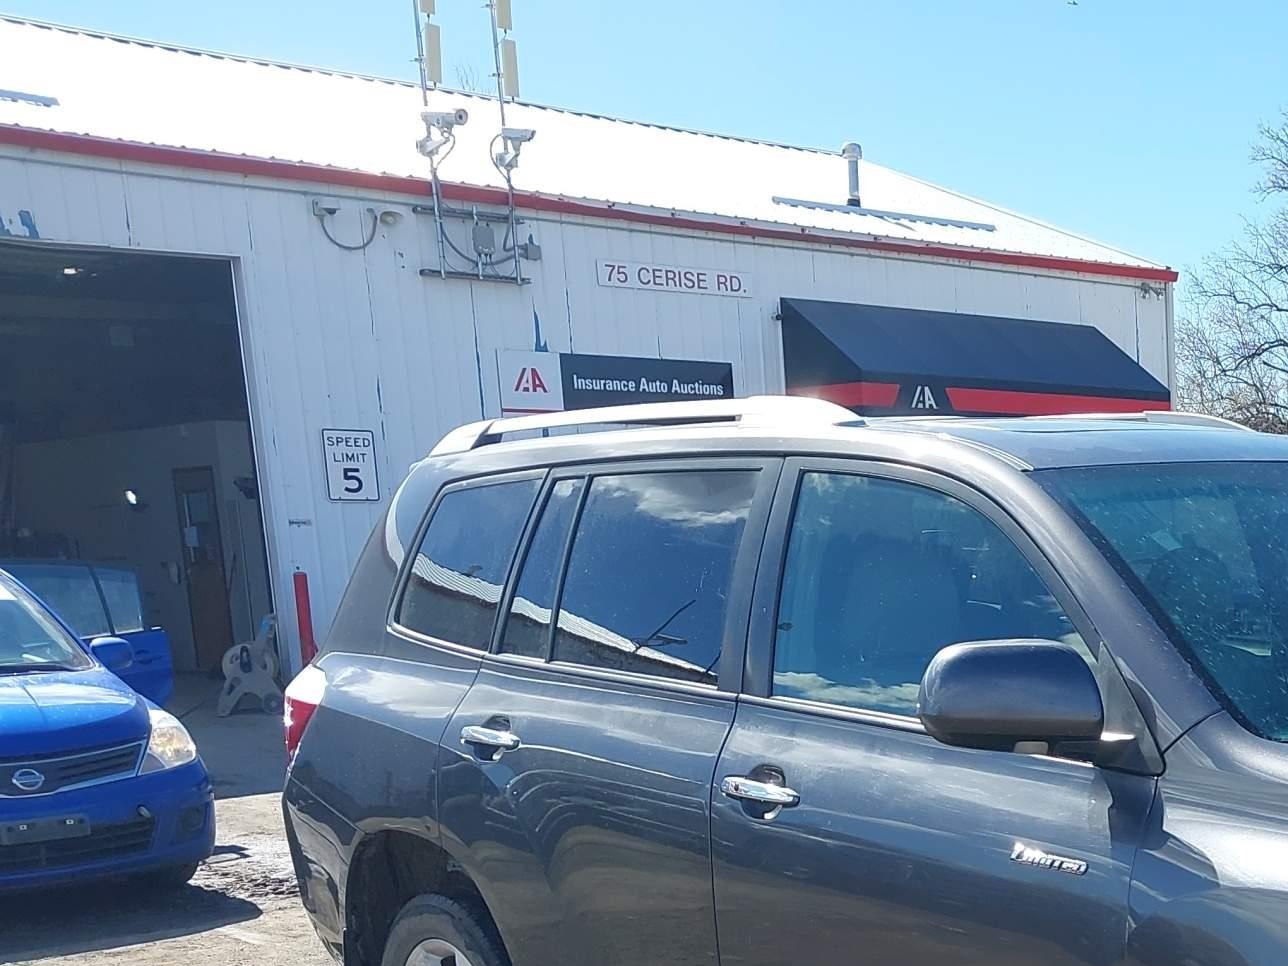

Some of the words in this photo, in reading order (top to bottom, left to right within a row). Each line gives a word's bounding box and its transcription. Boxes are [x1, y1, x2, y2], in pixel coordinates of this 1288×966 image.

[604, 264, 628, 283] 75
[637, 267, 708, 290] CERISE
[717, 274, 747, 293] RD.
[573, 374, 636, 392] Insurance
[639, 378, 668, 394] Auto
[671, 379, 724, 396] Auctions
[326, 436, 371, 448] SPEED
[333, 452, 367, 463] LIMIT
[343, 467, 363, 493] 5
